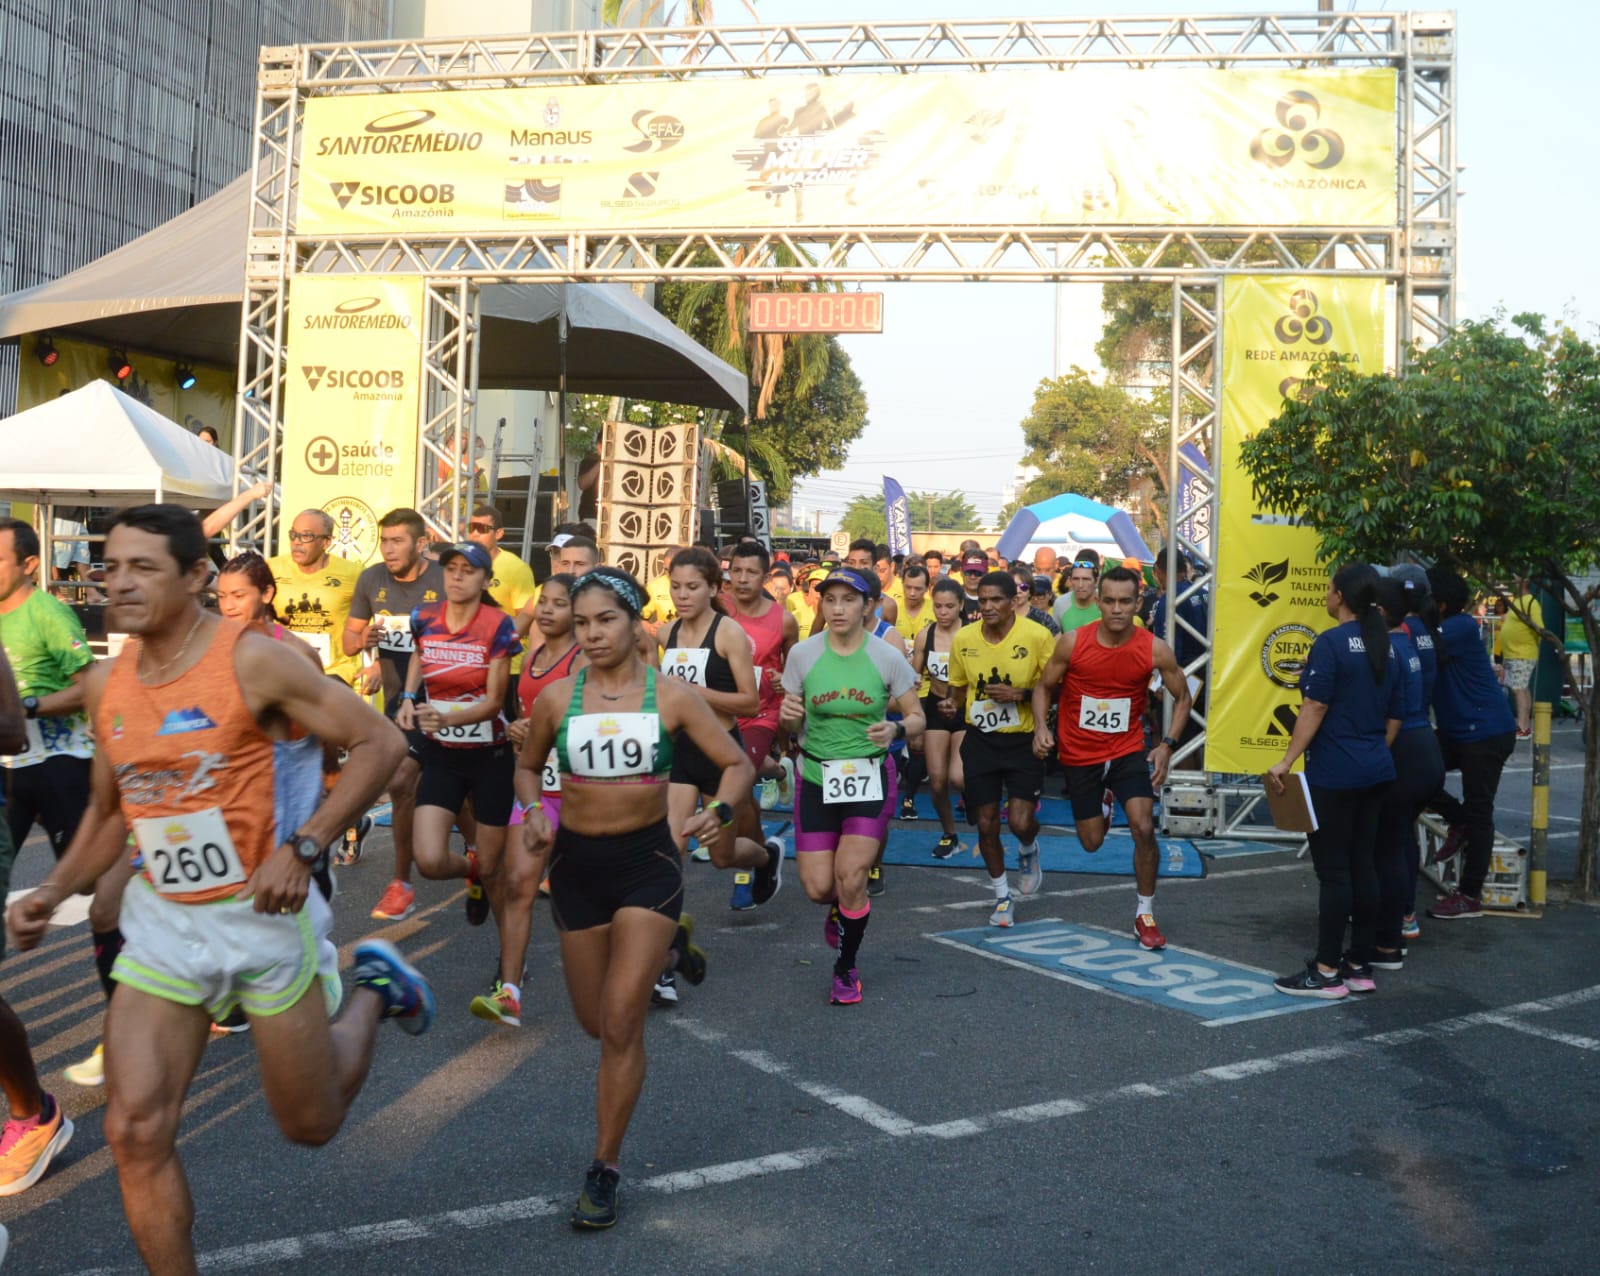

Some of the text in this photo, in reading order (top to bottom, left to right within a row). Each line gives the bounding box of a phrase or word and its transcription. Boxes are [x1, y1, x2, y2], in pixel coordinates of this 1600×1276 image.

[316, 130, 483, 156] SANTOREMÉDIO
[510, 128, 592, 147] Manaus
[361, 183, 455, 206] SICOOB
[392, 207, 454, 217] Amazônia
[303, 313, 412, 330] SANTOREMÉDIO
[755, 297, 878, 327] 00:00:00
[1245, 349, 1276, 361] REDE
[326, 370, 404, 388] SICOOB
[353, 391, 403, 401] Amazônia
[341, 440, 394, 458] saúde
[341, 459, 394, 477] atende
[893, 496, 907, 550] YARA
[380, 631, 414, 648] 427
[423, 647, 485, 664] RUNNERS
[666, 664, 699, 685] 482
[974, 708, 1011, 730] 204
[1084, 710, 1121, 729] 245
[1239, 736, 1279, 747] SILSEG
[579, 737, 643, 770] 119
[828, 775, 871, 798] 367
[154, 842, 229, 885] 260
[984, 929, 1277, 1005] IDOSO
